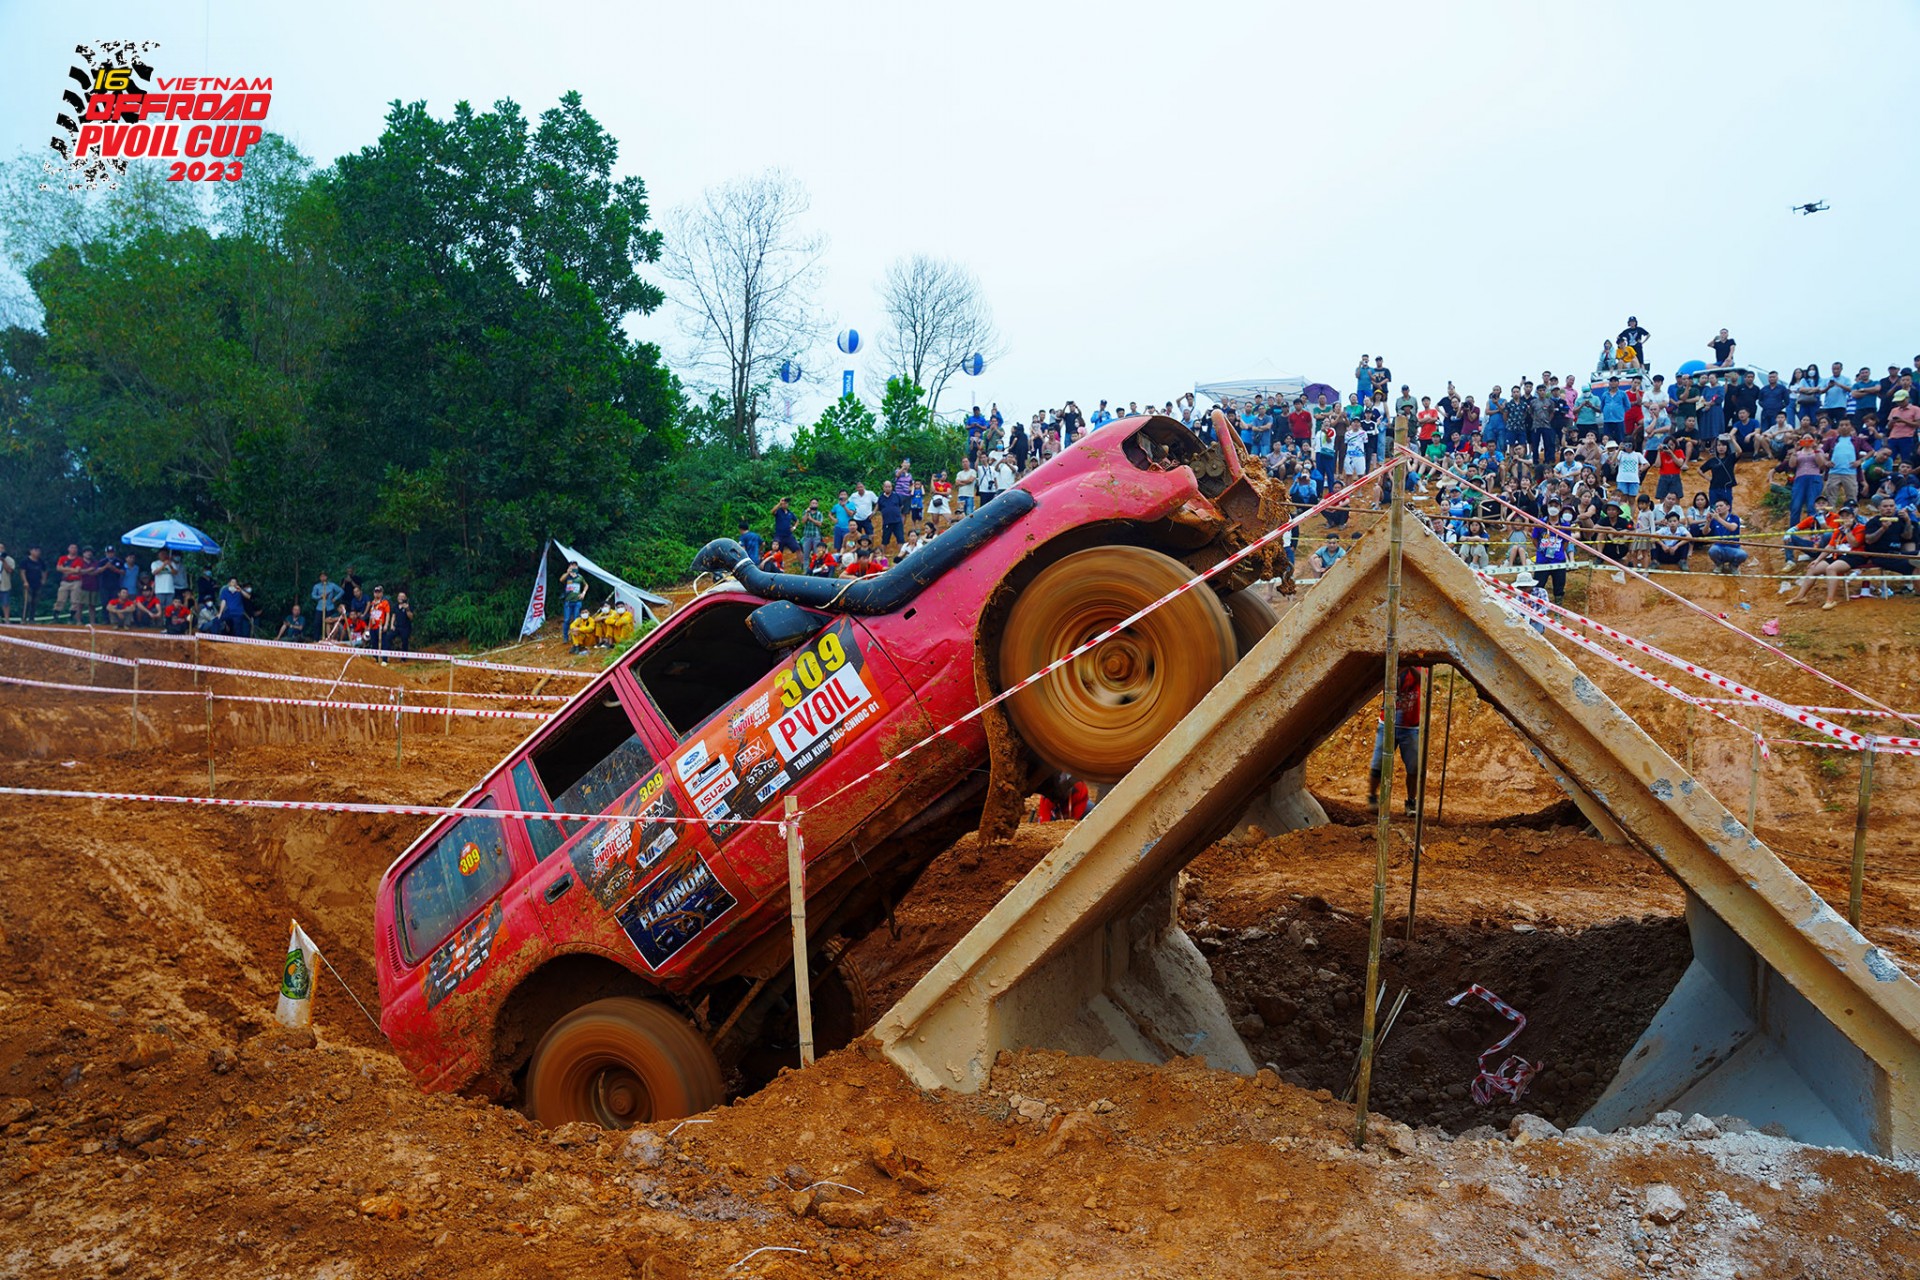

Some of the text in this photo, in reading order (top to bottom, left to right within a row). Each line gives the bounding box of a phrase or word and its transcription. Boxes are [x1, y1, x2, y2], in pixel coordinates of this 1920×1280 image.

[774, 632, 847, 708] 309
[778, 677, 860, 753] PVOIL
[638, 772, 664, 802] 309
[700, 777, 732, 807] ISUZU
[460, 849, 480, 873] 309
[593, 840, 617, 868] PVOIL
[615, 828, 632, 849] CUP
[639, 863, 711, 931] PLATINUM
